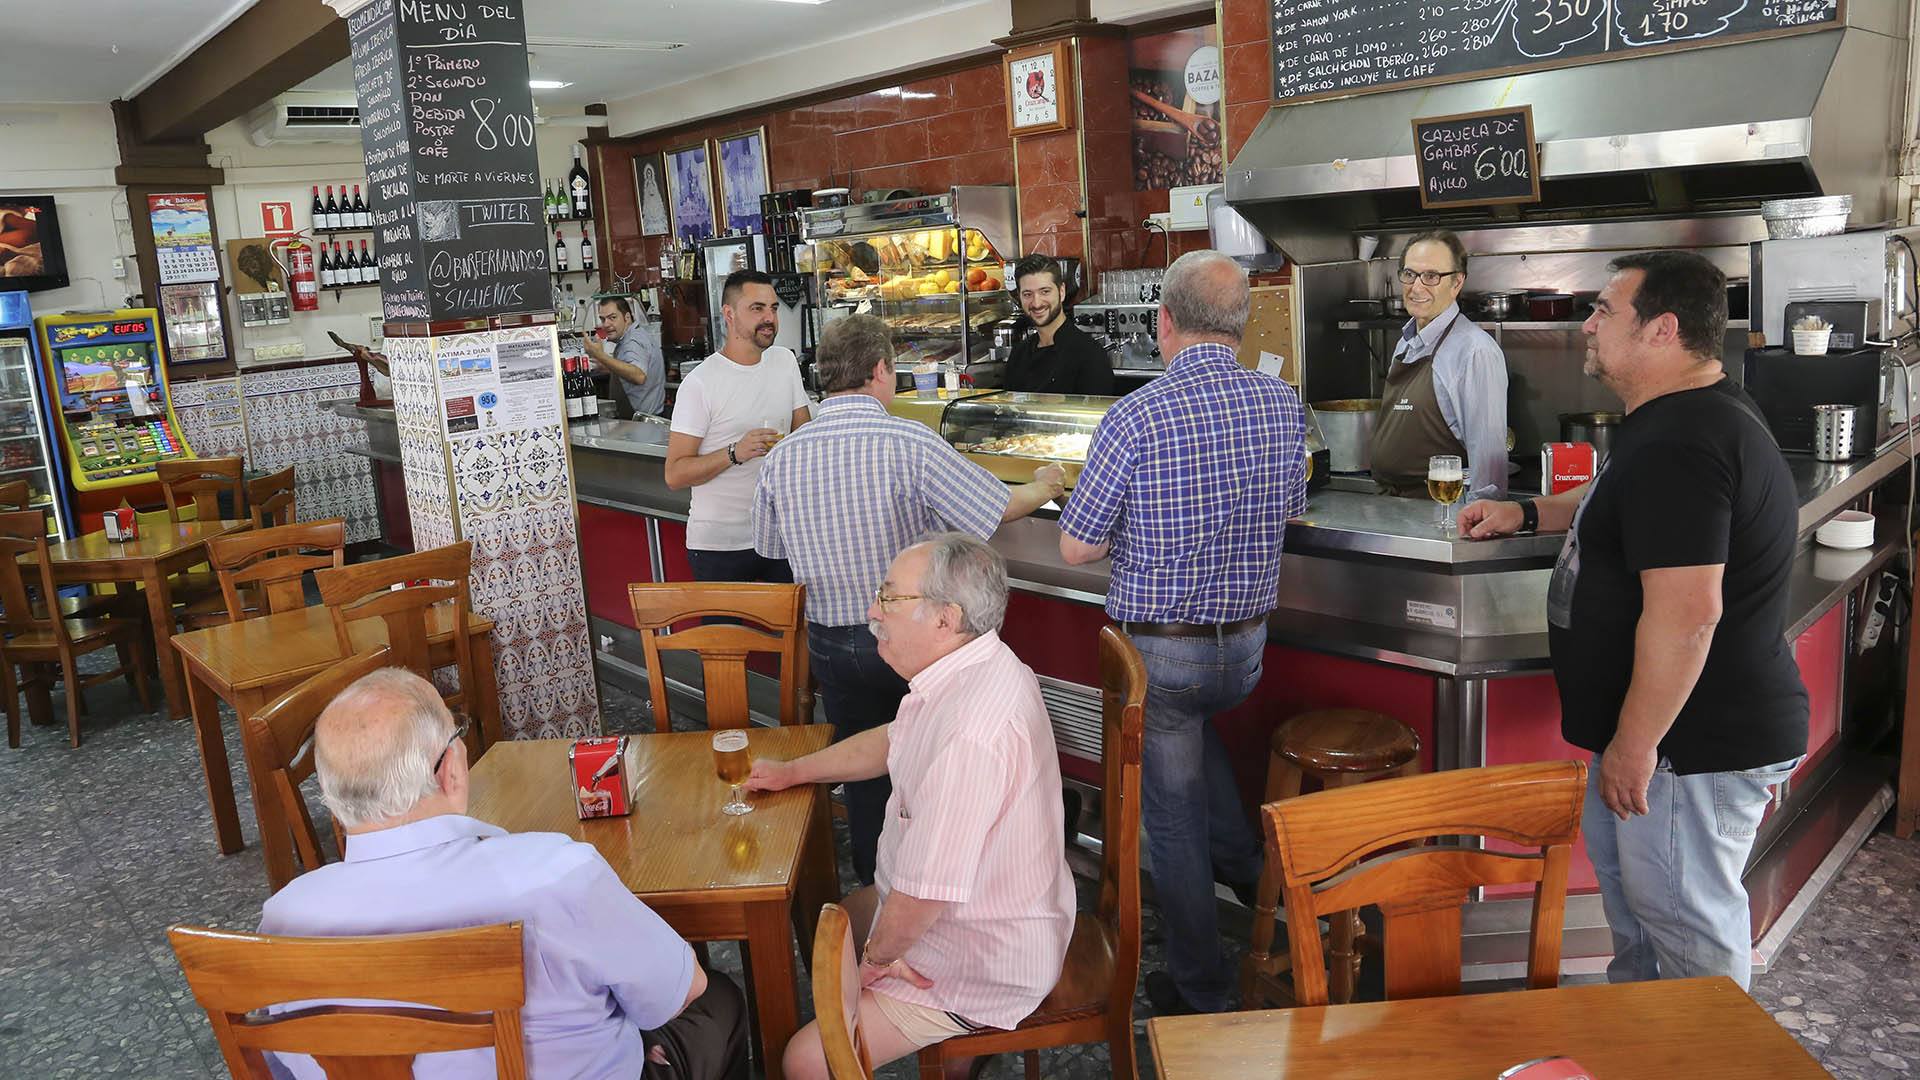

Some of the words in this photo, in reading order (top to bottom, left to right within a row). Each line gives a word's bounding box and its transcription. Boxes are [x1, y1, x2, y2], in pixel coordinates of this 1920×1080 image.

[400, 0, 466, 23] MENU
[478, 5, 516, 20] DEL
[1284, 22, 1296, 34] DE
[1301, 14, 1329, 27] JAMON
[1333, 5, 1357, 22] YORK
[1286, 41, 1298, 50] DE
[1302, 32, 1333, 45] PAVO
[1286, 56, 1298, 68] DE
[1304, 50, 1329, 64] CAÑA
[1332, 47, 1348, 58] DE
[1355, 42, 1387, 55] LOMO
[1288, 72, 1301, 84] DE
[1308, 57, 1370, 78] SALCHICHON
[425, 75, 486, 88] SEGUNDO
[1279, 88, 1295, 98] LOS
[1299, 79, 1334, 93] PRECIOS
[1386, 70, 1398, 79] EL
[410, 91, 442, 104] PAN
[412, 104, 466, 121] BEBIDA
[413, 120, 455, 138] POSTRE
[1422, 123, 1489, 142] CAZUELA
[1493, 119, 1518, 134] DE
[1424, 143, 1478, 161] GAMBAS
[1442, 160, 1457, 171] AL
[416, 170, 430, 184] DE
[434, 171, 469, 185] MARTE
[474, 172, 482, 182] A
[484, 170, 534, 184] VIERNES
[462, 203, 530, 222] TWITER
[437, 350, 465, 358] FATIMA
[1555, 474, 1589, 482] Cruzcampo
